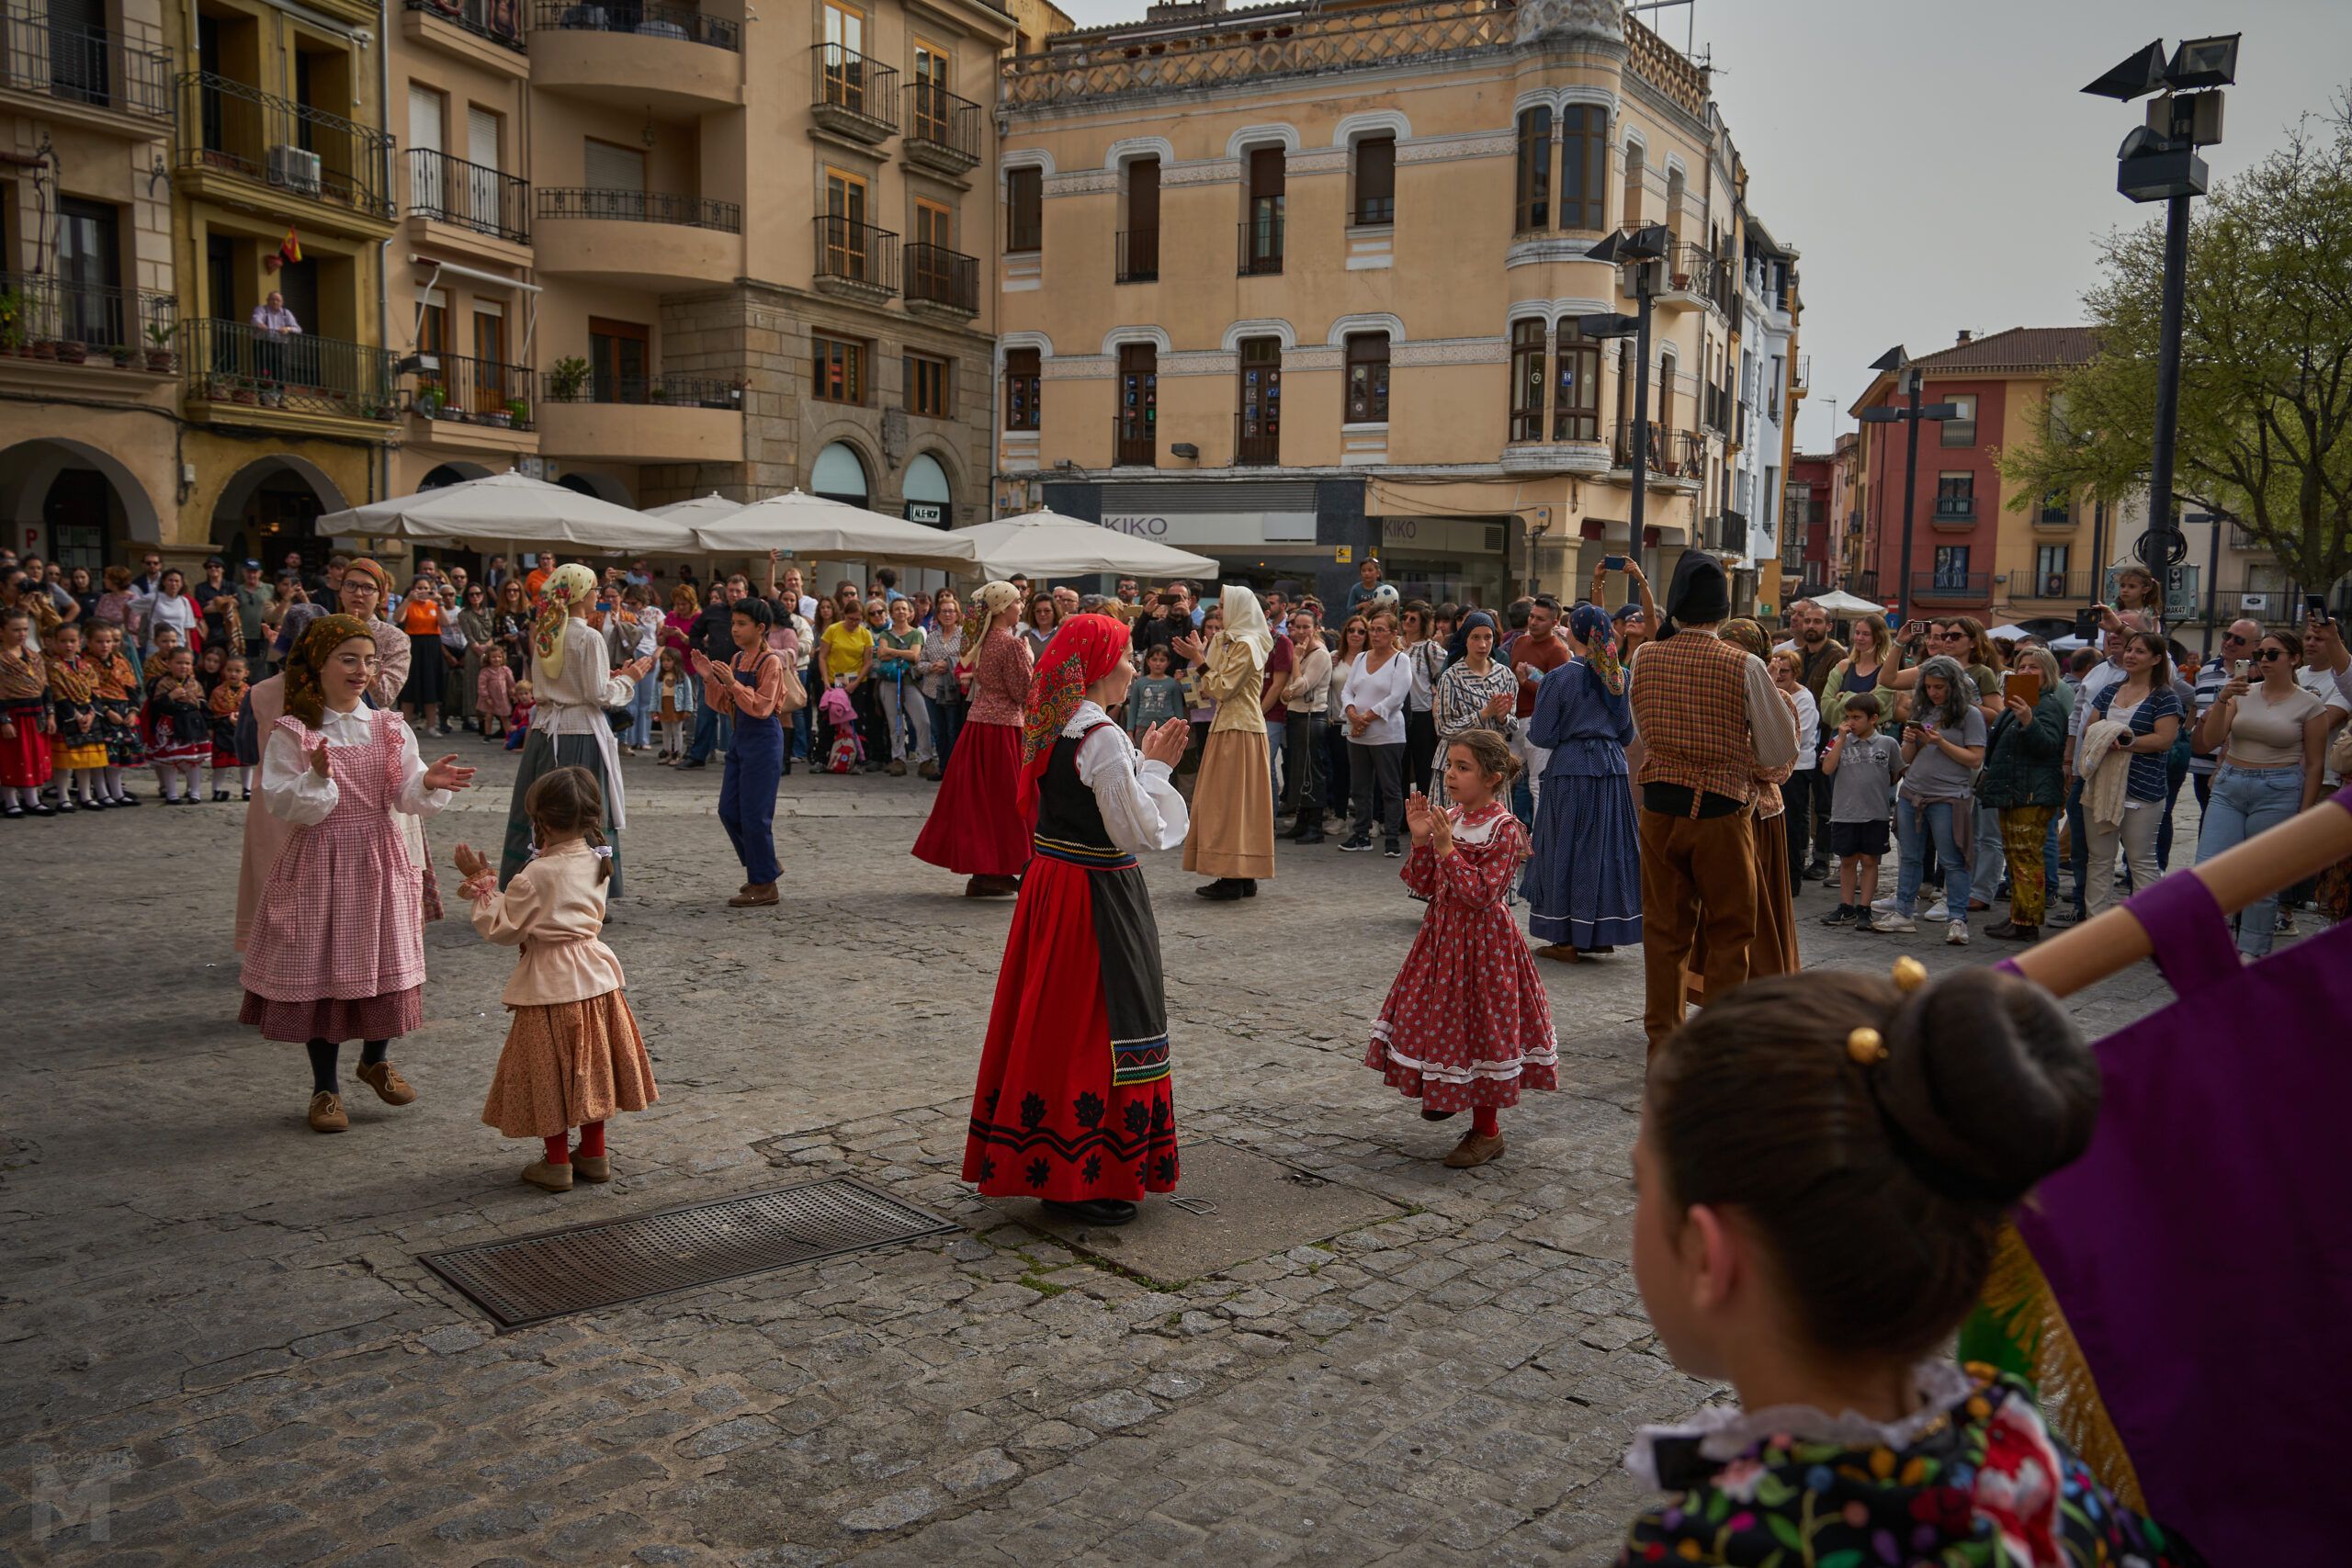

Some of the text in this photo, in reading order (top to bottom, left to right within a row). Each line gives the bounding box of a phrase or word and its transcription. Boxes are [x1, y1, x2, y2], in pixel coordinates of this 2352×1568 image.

[1104, 517, 1168, 536] KIKO
[1384, 519, 1417, 539] KIKO
[25, 527, 39, 548] P
